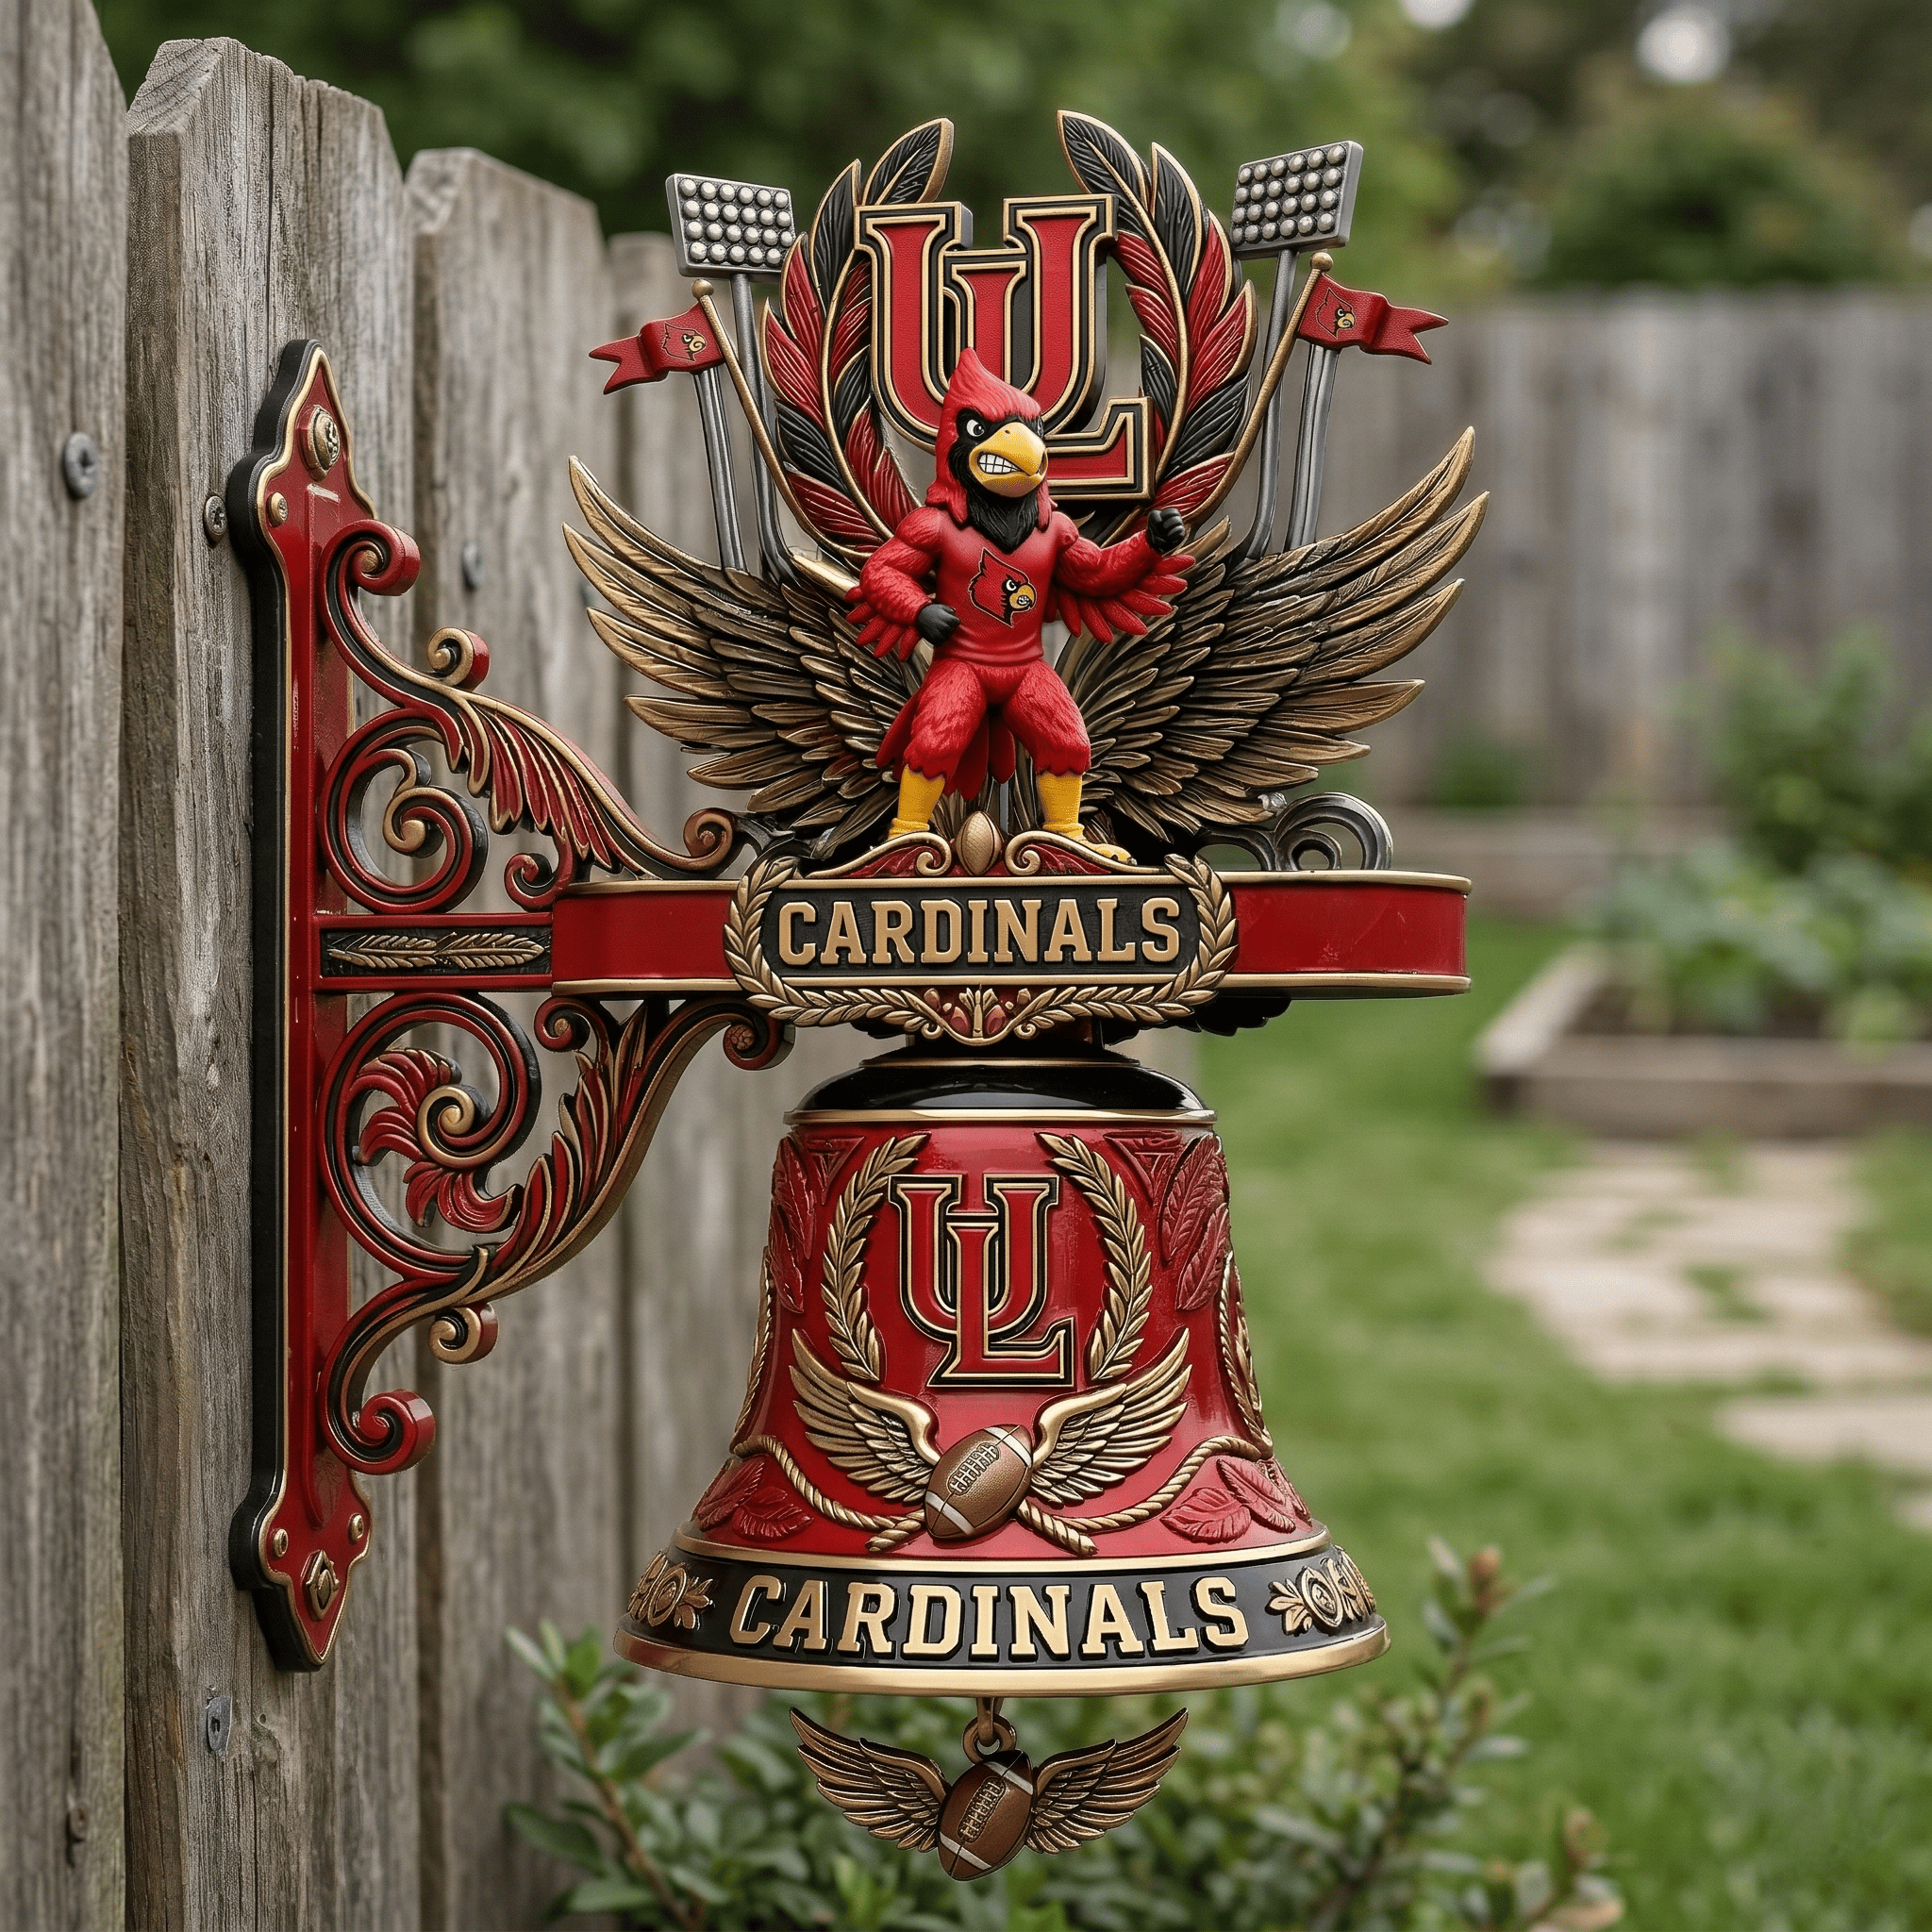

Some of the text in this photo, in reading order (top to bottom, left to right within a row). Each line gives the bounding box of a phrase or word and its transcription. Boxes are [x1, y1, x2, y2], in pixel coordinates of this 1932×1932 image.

[777, 897, 1182, 965] CARDINALS
[888, 1174, 1074, 1387] UL
[730, 1574, 1247, 1659] CARDINALS
